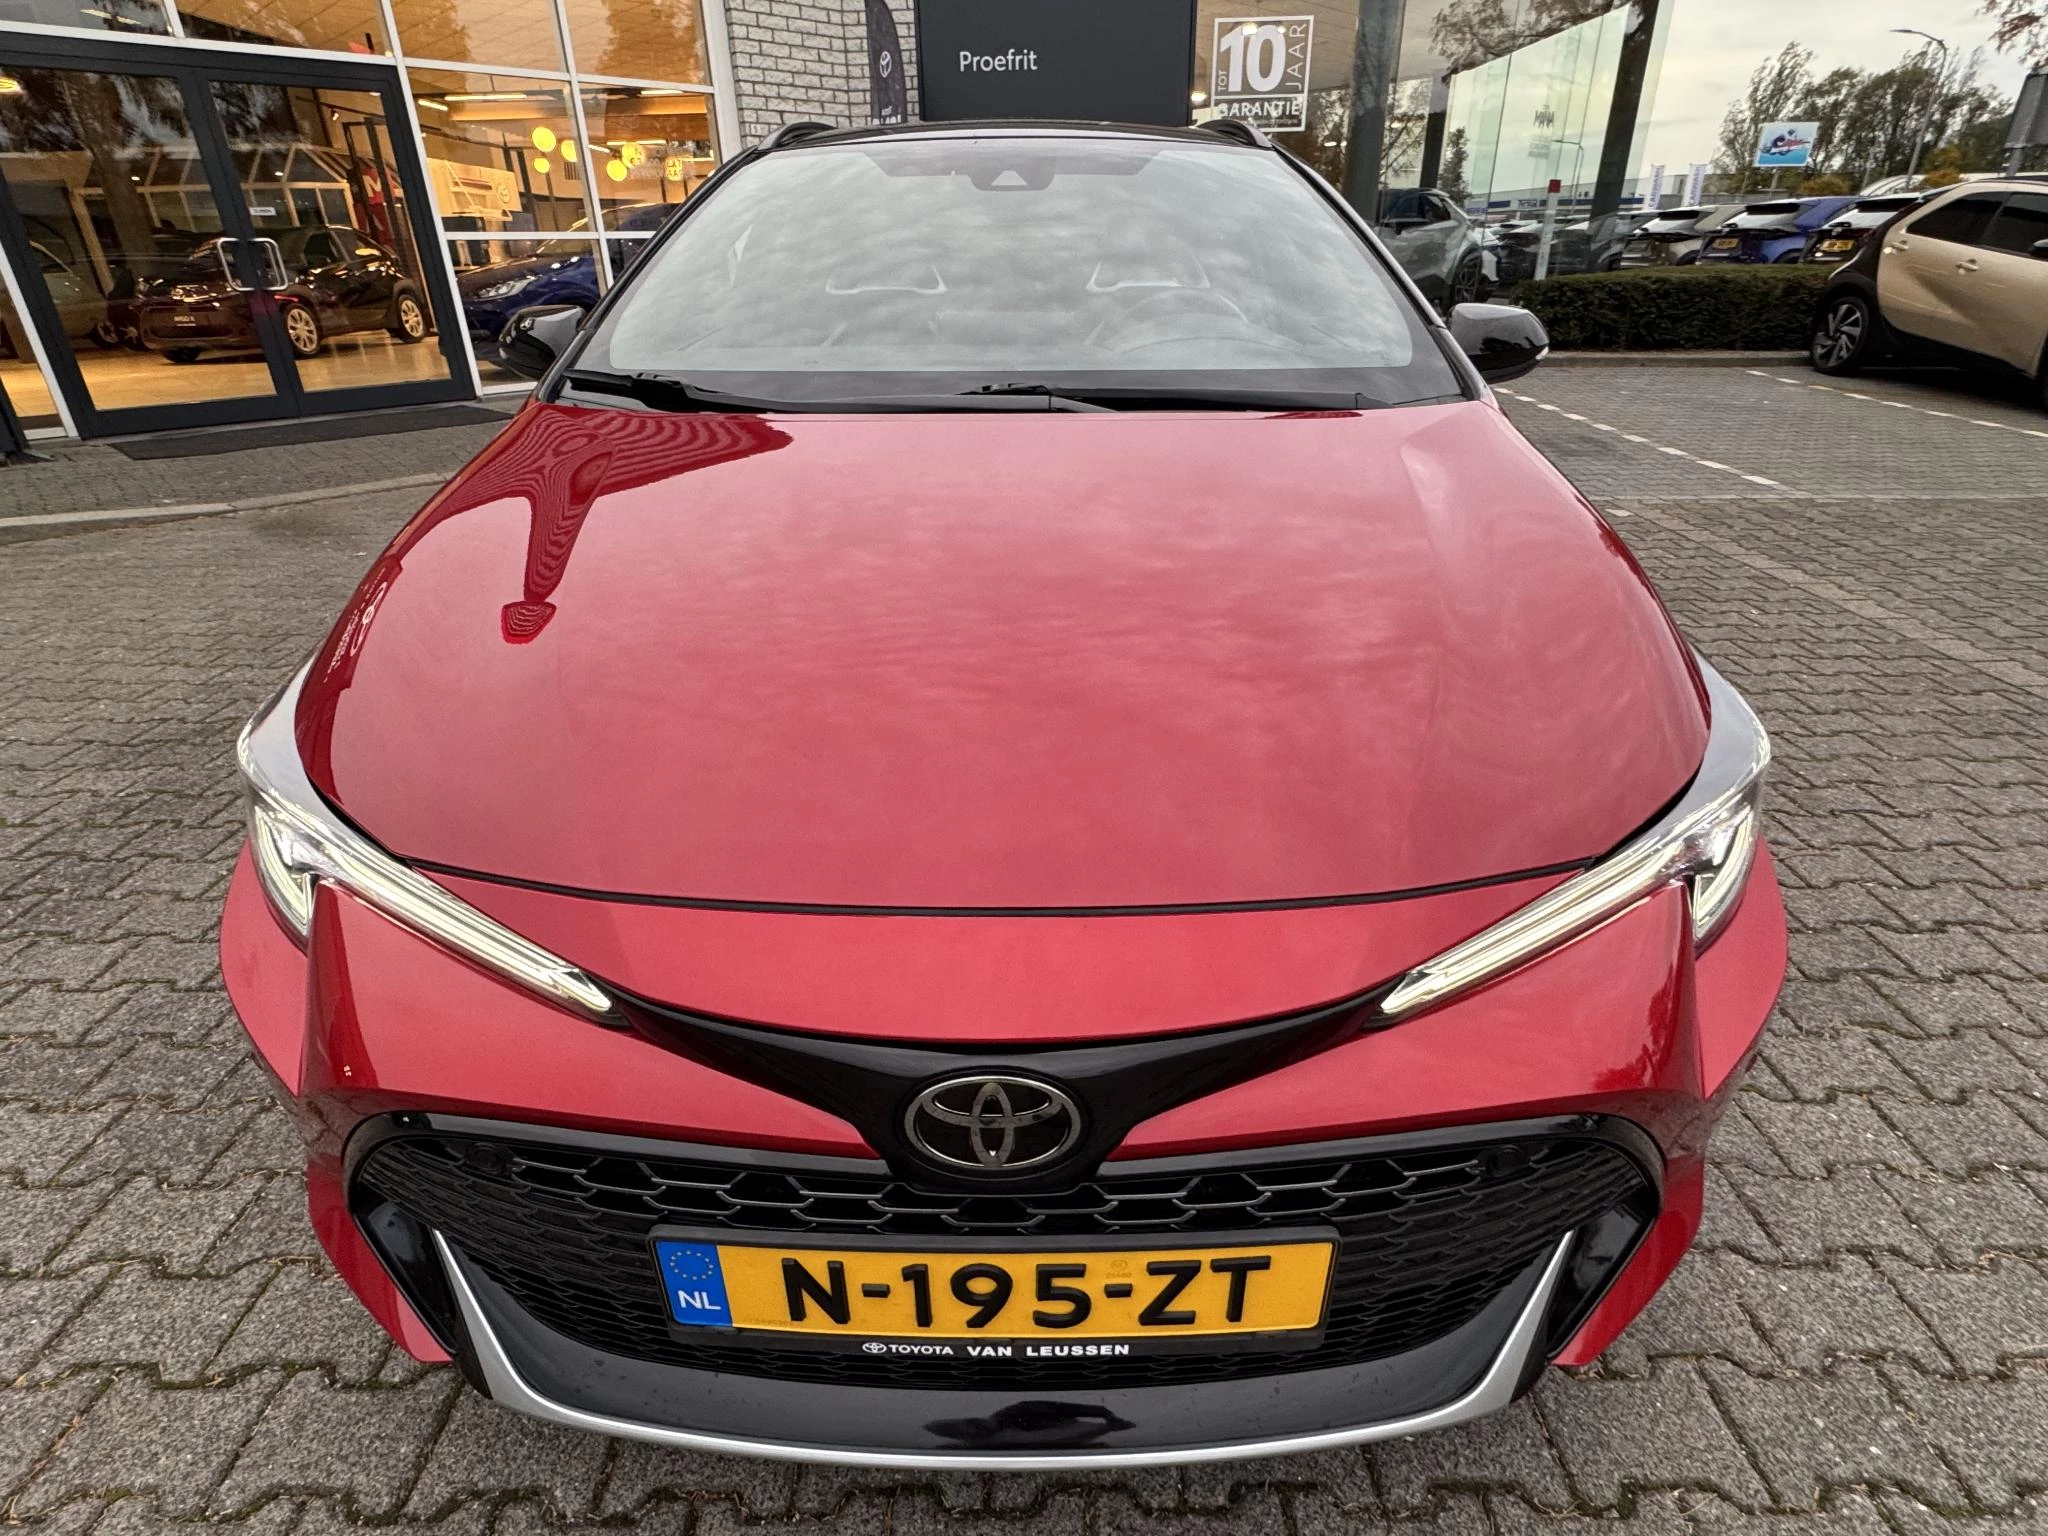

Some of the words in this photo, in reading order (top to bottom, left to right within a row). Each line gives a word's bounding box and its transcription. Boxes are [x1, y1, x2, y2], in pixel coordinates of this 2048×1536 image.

[959, 48, 1038, 72] Proefrit
[1219, 24, 1286, 92] 10
[1285, 23, 1306, 91] JAAR
[1218, 70, 1227, 92] TOT
[1217, 101, 1301, 117] GARANTIE
[677, 1290, 721, 1311] NL
[781, 1255, 1272, 1329] N-195-ZT
[888, 1343, 954, 1356] TOYOTA
[966, 1345, 1012, 1357] VAN
[1026, 1344, 1130, 1357] LEUSSEN
